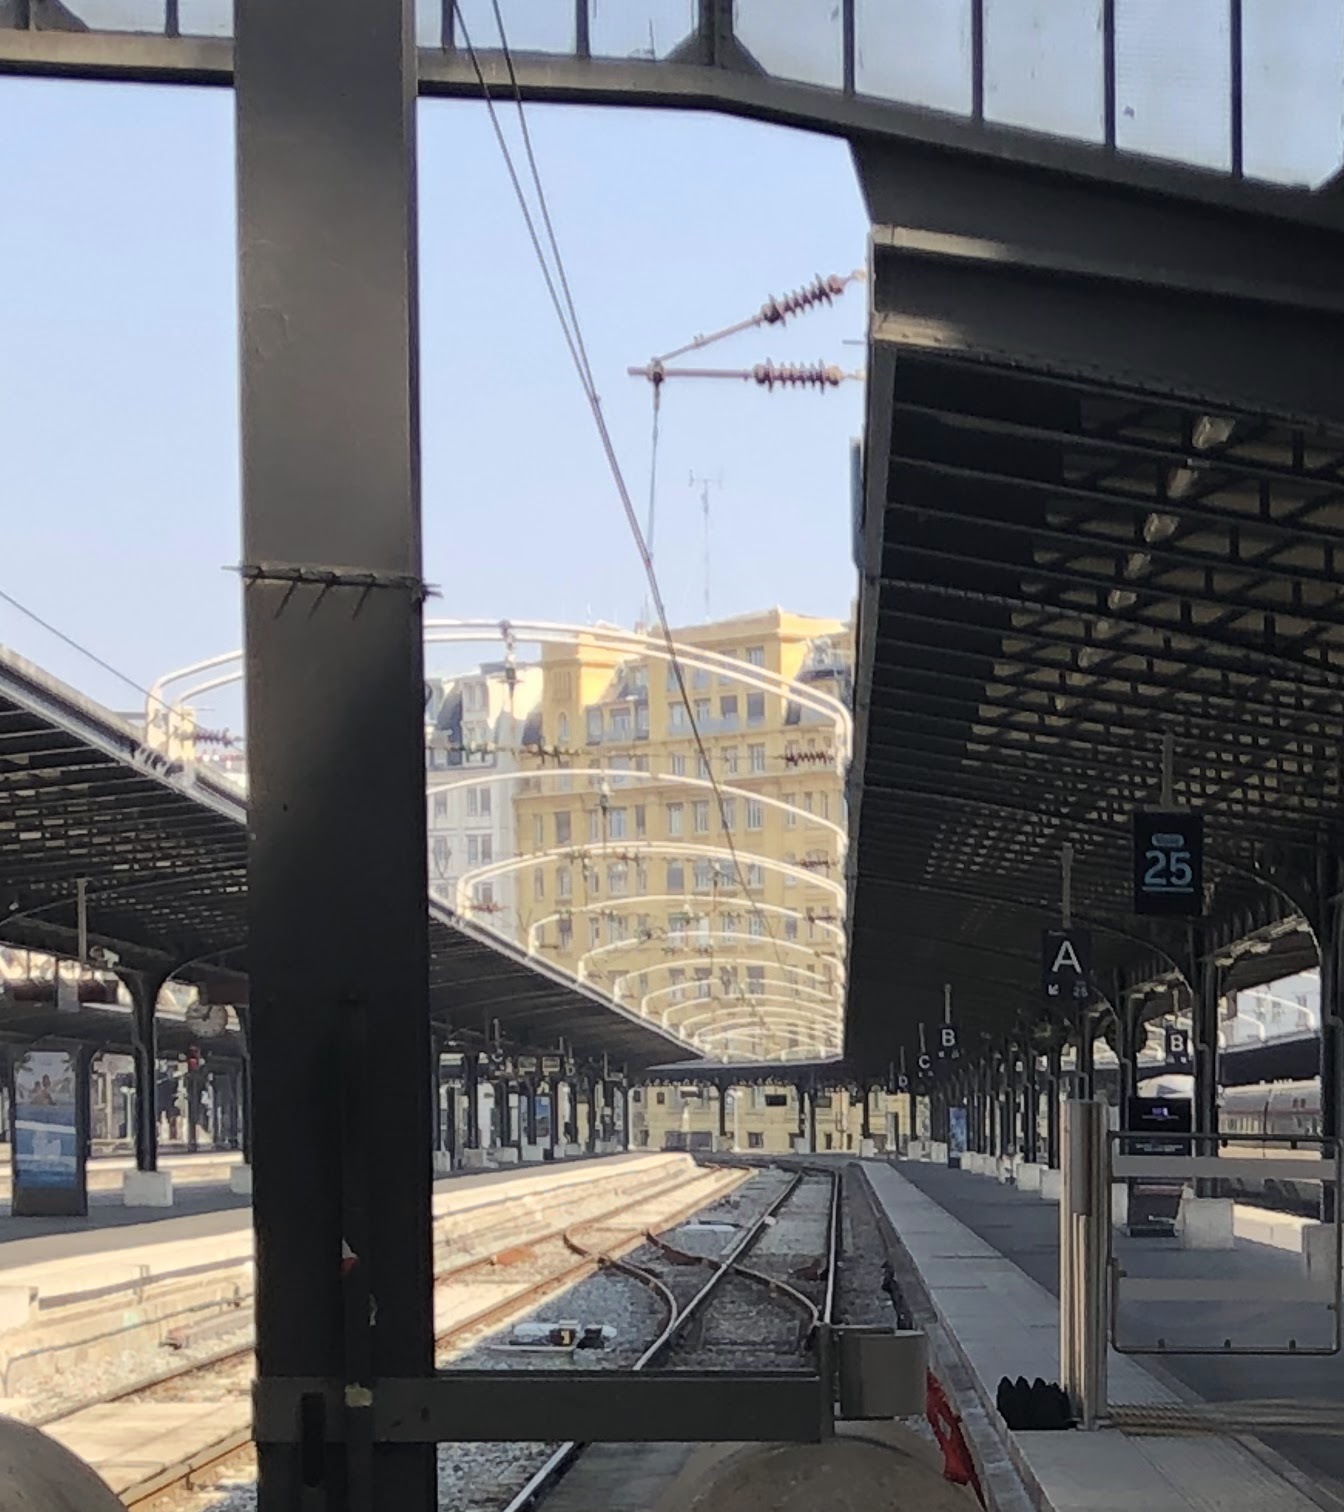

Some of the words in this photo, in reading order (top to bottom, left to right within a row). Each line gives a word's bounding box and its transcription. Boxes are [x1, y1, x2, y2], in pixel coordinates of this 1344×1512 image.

[1144, 850, 1193, 886] 25
[1052, 940, 1082, 974] A
[942, 1029, 956, 1046] B
[1170, 1034, 1184, 1052] B
[918, 1055, 931, 1069] C
